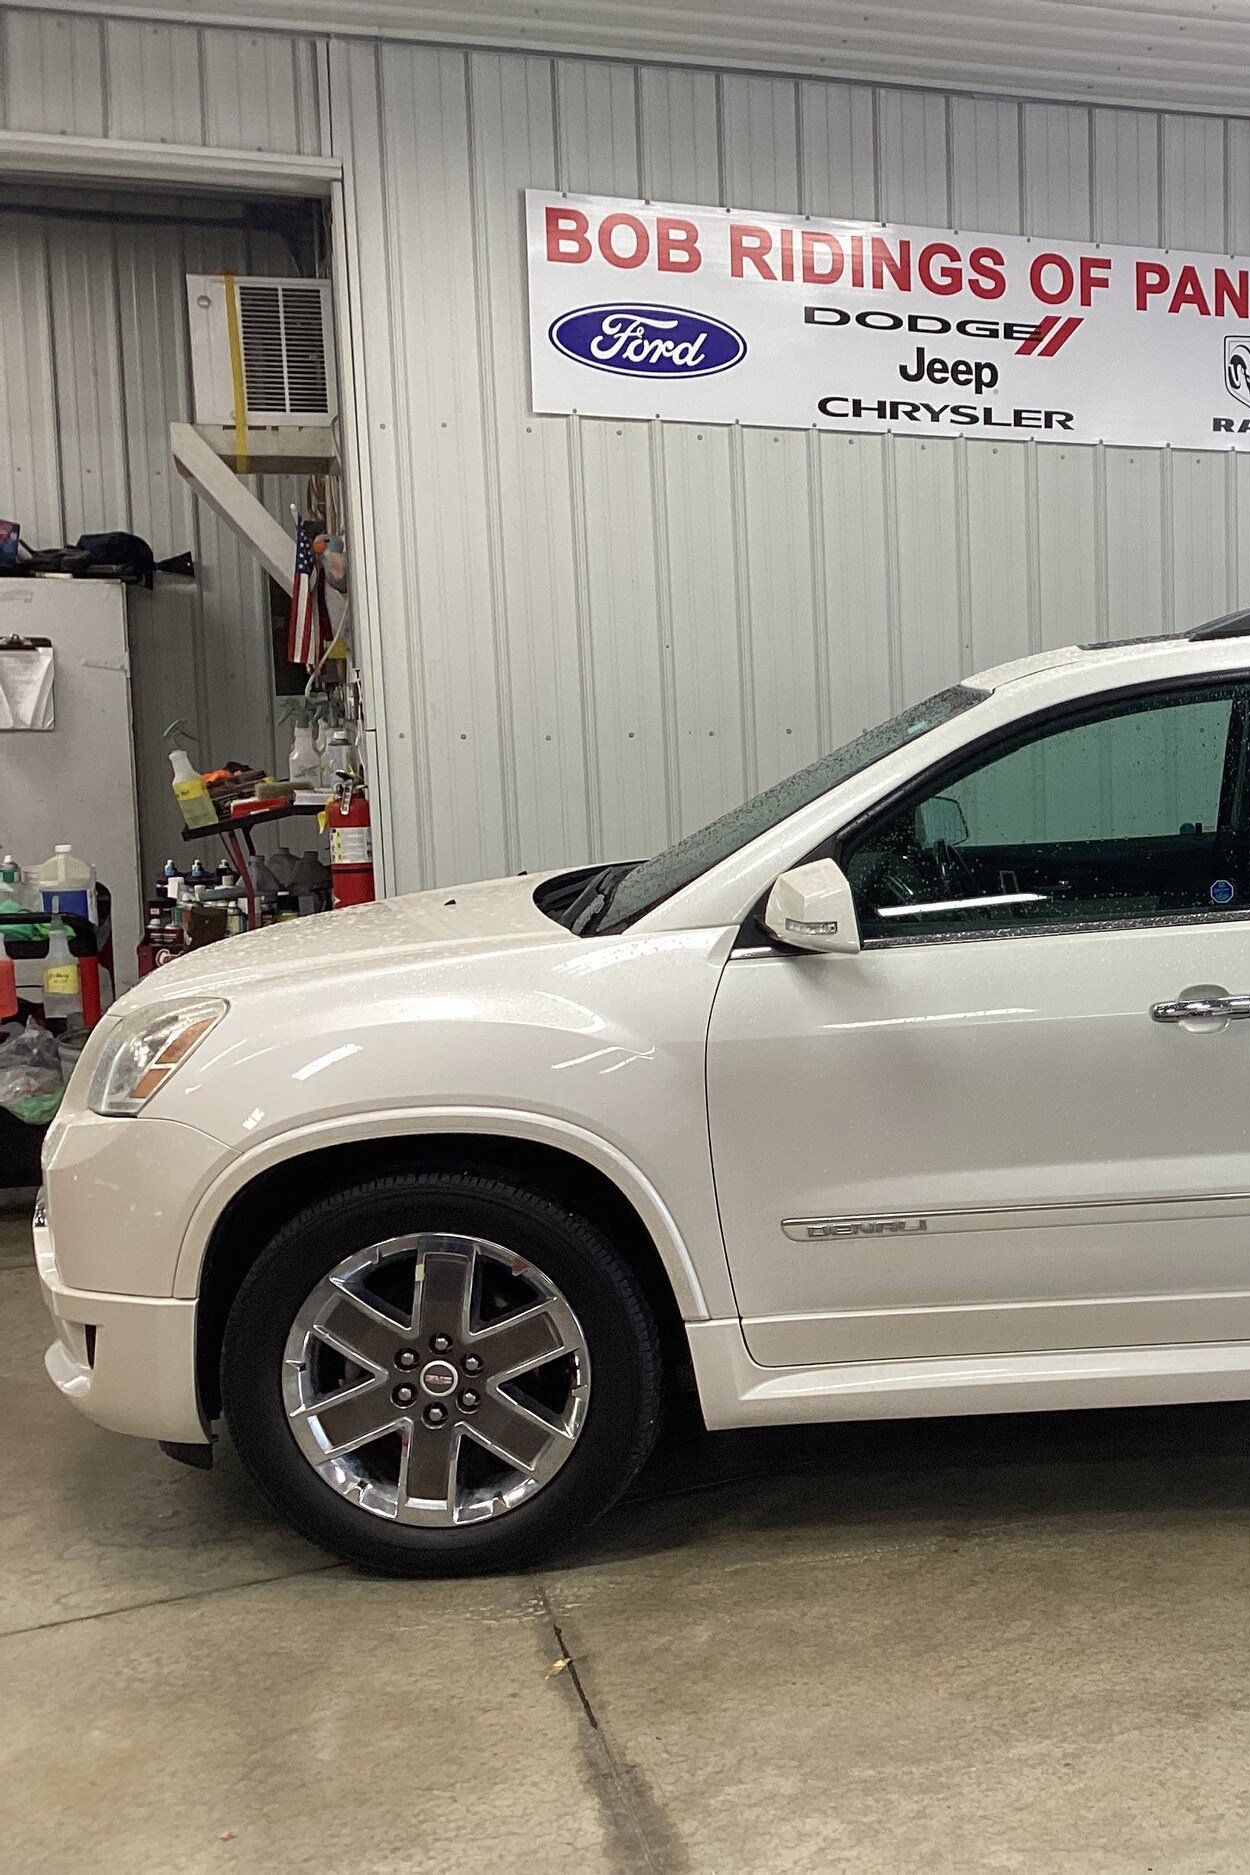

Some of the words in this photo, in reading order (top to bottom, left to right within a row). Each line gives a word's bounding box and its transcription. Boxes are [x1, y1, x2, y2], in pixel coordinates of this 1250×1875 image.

[544, 206, 703, 274] BOB
[729, 224, 1008, 301] RIDINGS
[1029, 253, 1112, 308] OF
[590, 313, 709, 367] Ford
[804, 306, 1044, 343] DODGE
[898, 346, 999, 395] Jeep
[817, 396, 1075, 431] CHRYSLER
